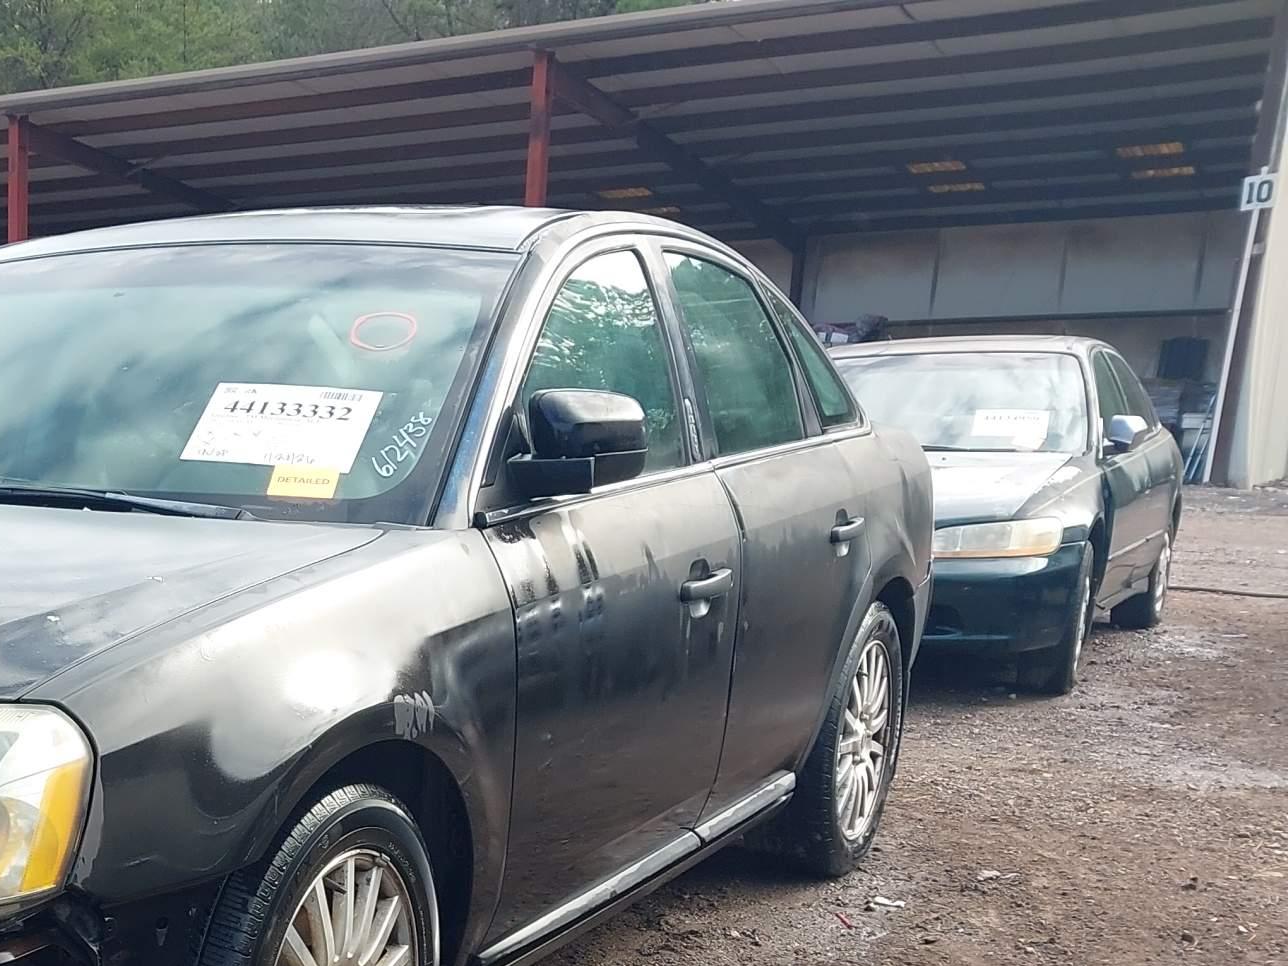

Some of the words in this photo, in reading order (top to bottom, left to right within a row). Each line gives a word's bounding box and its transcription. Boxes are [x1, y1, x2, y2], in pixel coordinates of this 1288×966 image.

[1246, 180, 1273, 204] 10
[223, 400, 353, 421] 44133332
[277, 476, 330, 485] DETAILED
